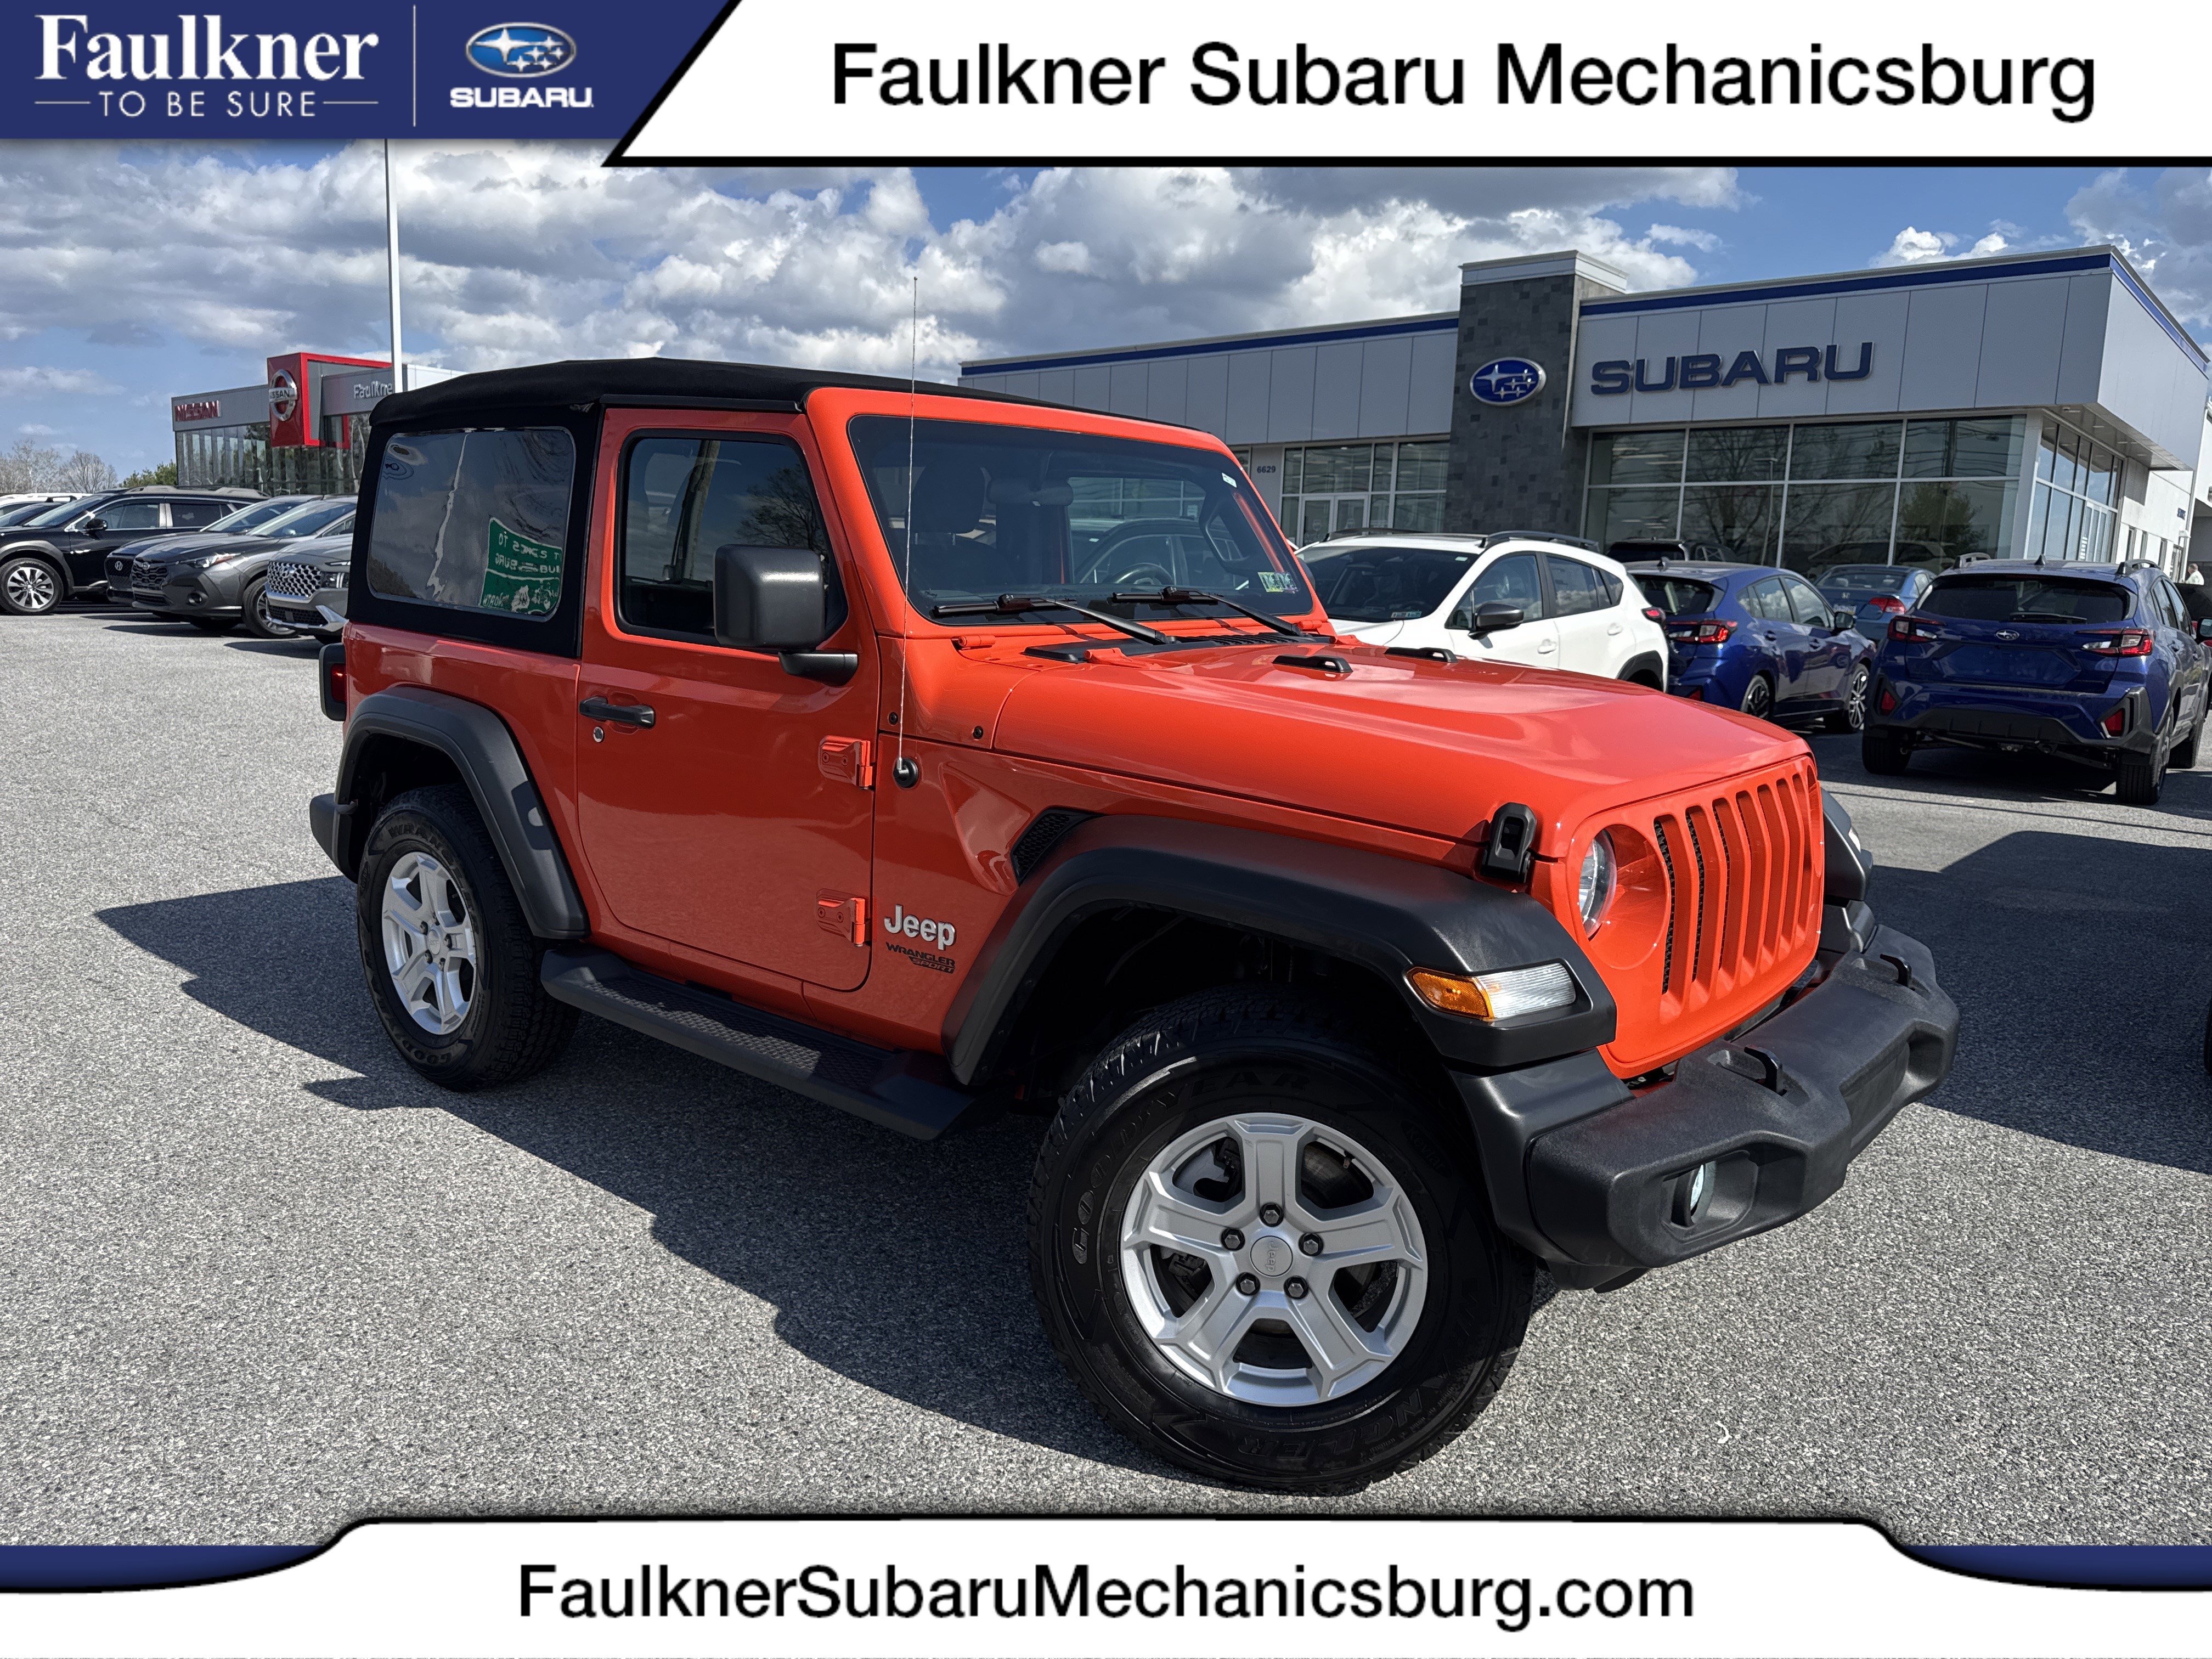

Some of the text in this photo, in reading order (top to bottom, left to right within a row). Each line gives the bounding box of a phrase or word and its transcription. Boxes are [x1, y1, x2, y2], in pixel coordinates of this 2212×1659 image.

[1591, 341, 1875, 396] SUBARU
[354, 380, 394, 399] Faulkne
[174, 400, 221, 422] NISSAN
[1257, 465, 1276, 473] 6629
[884, 904, 956, 951] Jeep
[885, 941, 956, 967] WRANGLER
[911, 957, 955, 974] SPORT
[1265, 1240, 1279, 1273] Jeep
